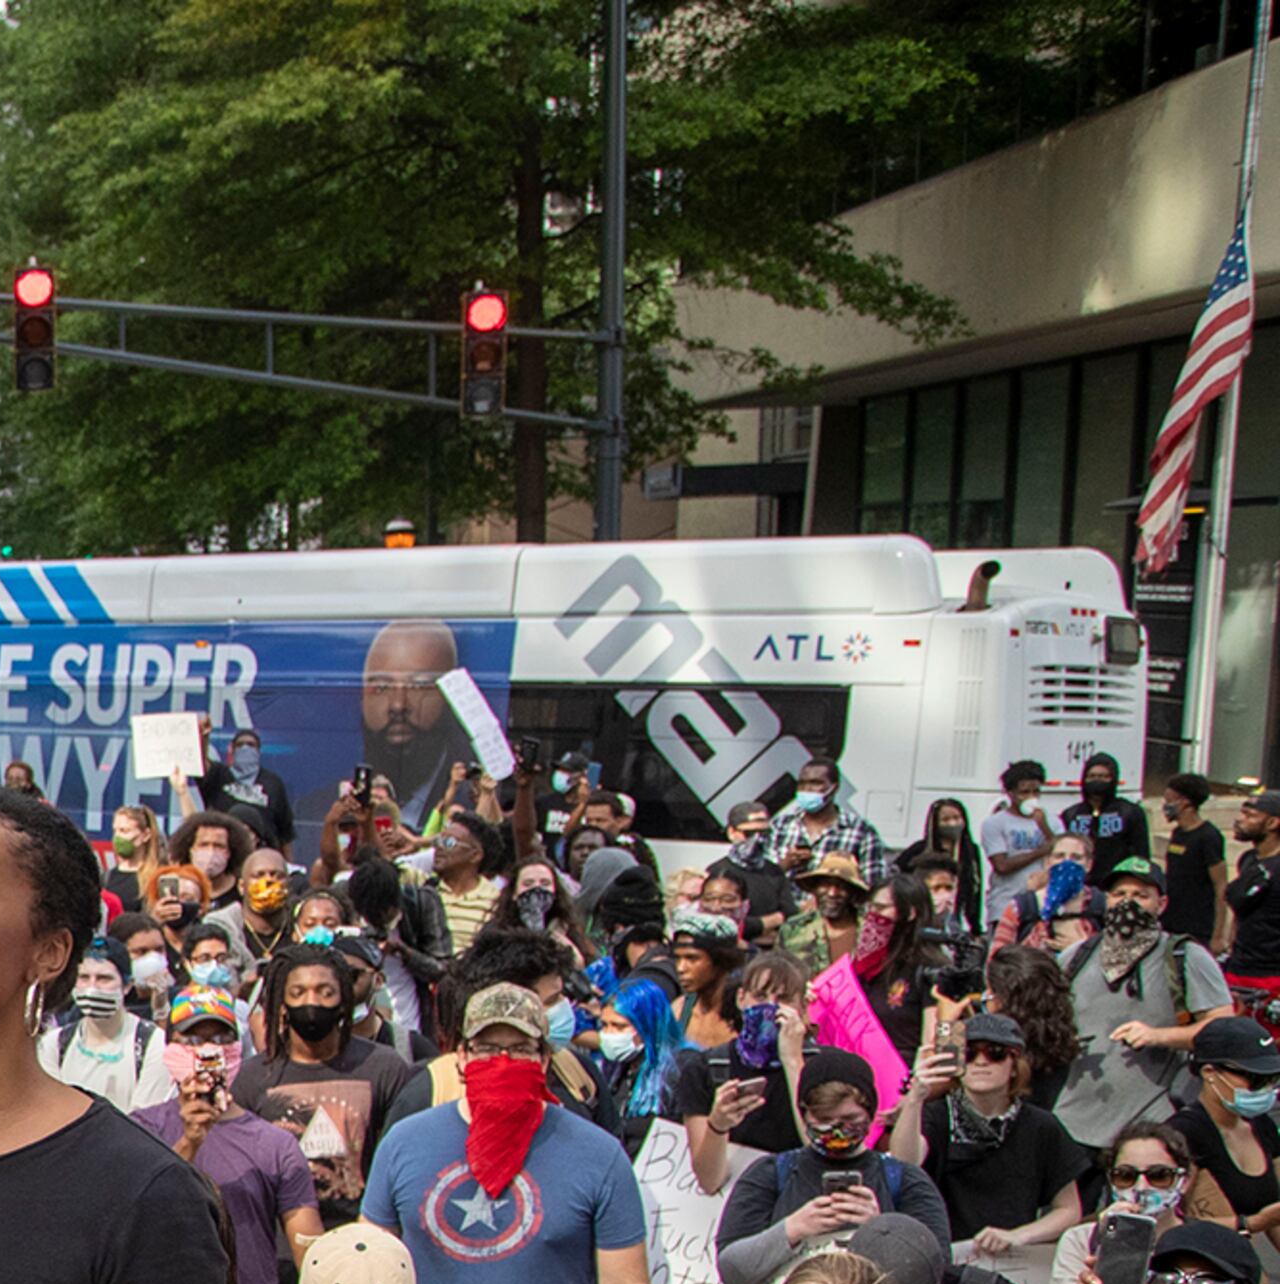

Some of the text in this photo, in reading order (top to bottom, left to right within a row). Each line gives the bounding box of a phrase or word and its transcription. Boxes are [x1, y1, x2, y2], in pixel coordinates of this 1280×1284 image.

[753, 634, 834, 662] ATL
[45, 642, 258, 729] SUPER
[650, 1203, 716, 1263] Fuck
